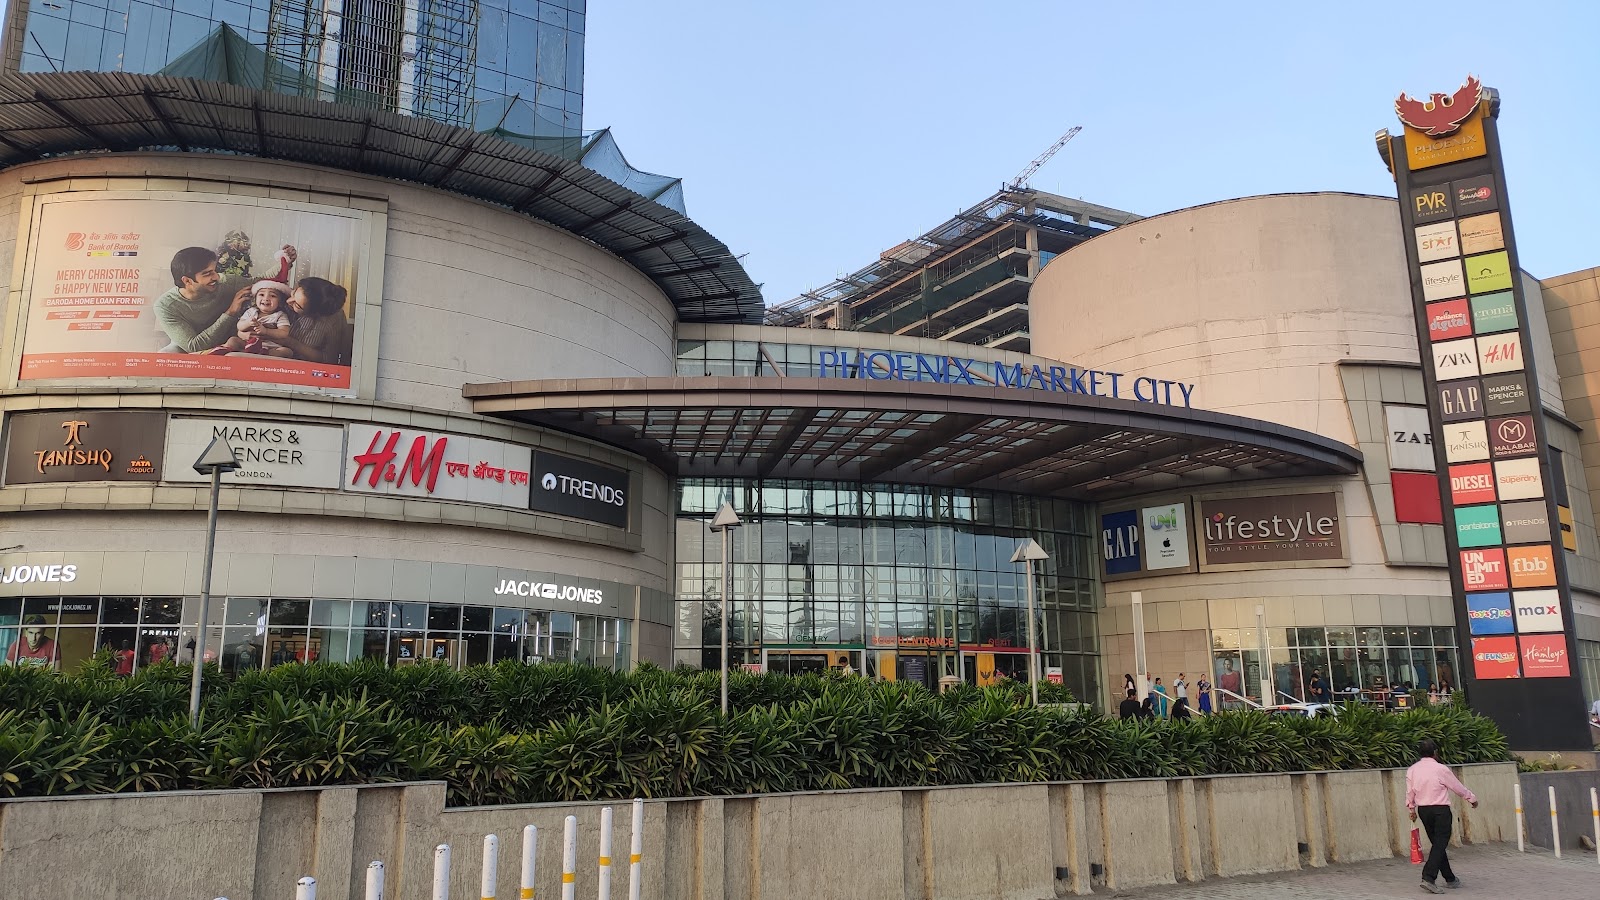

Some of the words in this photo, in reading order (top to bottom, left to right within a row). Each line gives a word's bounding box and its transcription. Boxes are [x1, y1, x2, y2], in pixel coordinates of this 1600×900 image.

[1414, 134, 1477, 155] PHOENIX
[1415, 191, 1447, 212] PVR
[1418, 208, 1448, 217] CINEMAS
[88, 243, 106, 251] Bank
[106, 243, 115, 251] of
[114, 243, 139, 251] Baroda
[56, 269, 87, 281] MERRY
[88, 269, 140, 280] CHRISTMAS
[1425, 274, 1460, 286] lifestyle
[54, 283, 60, 294] &
[62, 283, 91, 294] HAPPY
[92, 283, 113, 293] NEW
[115, 282, 139, 293] YEAR
[46, 298, 74, 306] BARODA
[1430, 314, 1469, 332] digital
[1437, 352, 1472, 368] ZARA
[1483, 342, 1516, 364] H&M
[819, 350, 975, 386] PHOENIX
[994, 361, 1124, 399] MARKET
[1133, 376, 1195, 408] CITY
[1488, 384, 1515, 393] MARKS
[1488, 390, 1525, 401] SPENCER
[1441, 386, 1478, 415] GAP
[213, 425, 283, 444] MARKS
[287, 430, 300, 444] &
[1494, 442, 1536, 452] MALABAR
[233, 446, 303, 465] ENCER
[352, 430, 448, 494] H&M
[234, 470, 273, 479] LONDON
[1451, 474, 1493, 491] DIESEL
[558, 474, 625, 507] TRENDS
[1205, 511, 1334, 542] lifestyle
[1458, 521, 1499, 533] pantaloons
[1512, 518, 1546, 526] TRENDS
[1102, 524, 1139, 561] GAP
[1463, 551, 1485, 564] UN
[1512, 556, 1548, 573] fbb
[2, 564, 78, 584] JONES
[1465, 561, 1501, 574] LIMIT
[1466, 572, 1486, 585] ED
[494, 579, 543, 598] JACK
[557, 585, 603, 605] JONES
[1518, 605, 1558, 617] max
[871, 635, 904, 646] SOUTH
[904, 636, 955, 648] ENTRANCE
[1523, 644, 1565, 663] Hamleys
